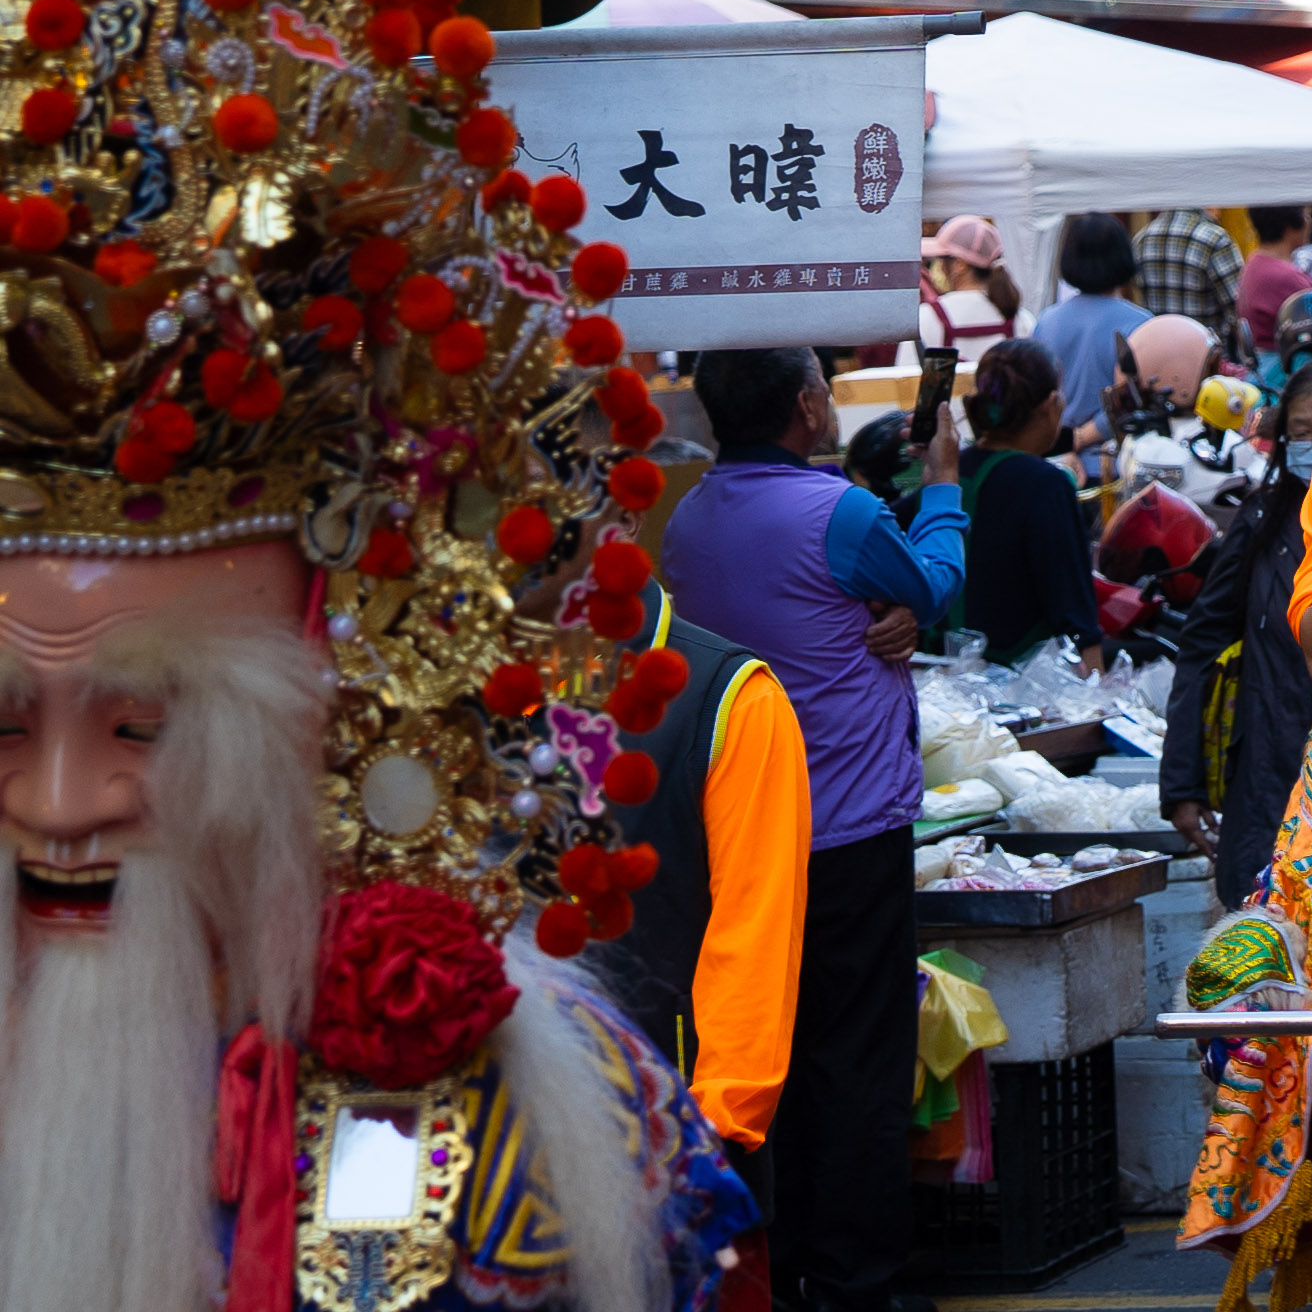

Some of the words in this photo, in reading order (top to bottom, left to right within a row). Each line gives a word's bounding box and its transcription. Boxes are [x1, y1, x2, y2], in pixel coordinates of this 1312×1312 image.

[603, 122, 826, 222] 大暐
[861, 131, 889, 207] 鮮嫩雞
